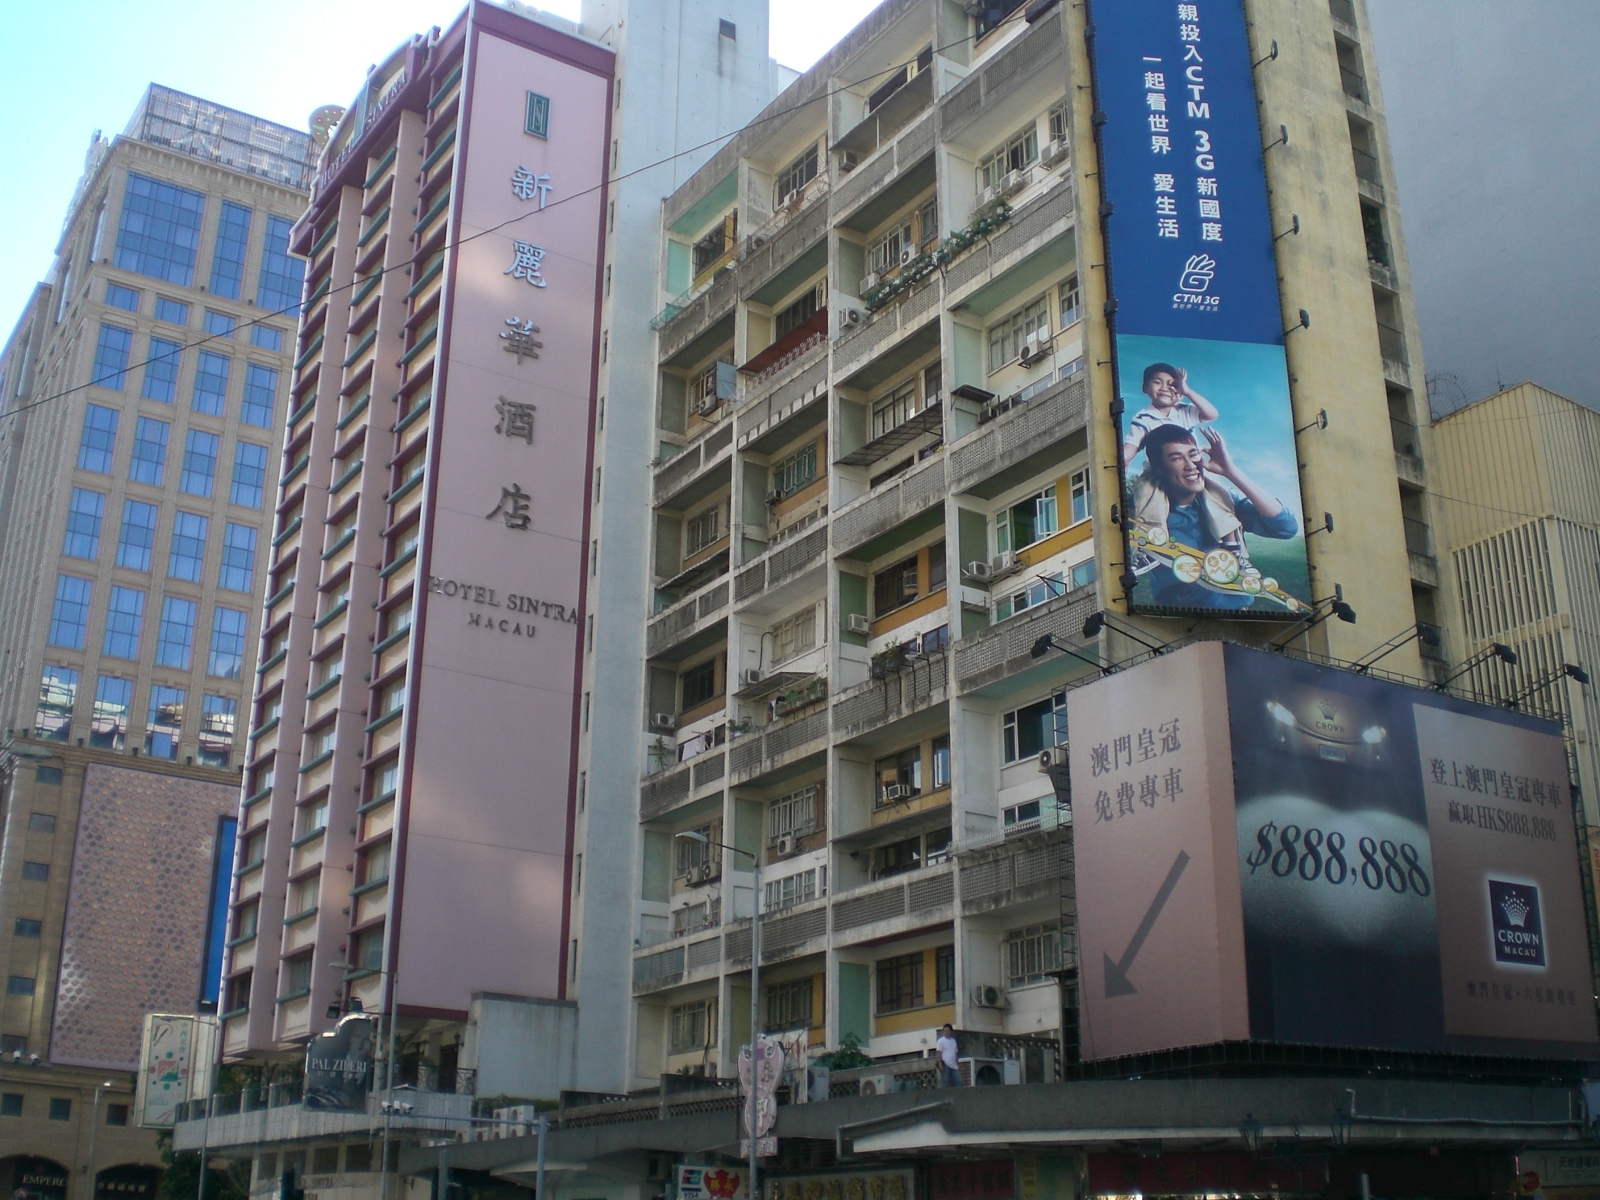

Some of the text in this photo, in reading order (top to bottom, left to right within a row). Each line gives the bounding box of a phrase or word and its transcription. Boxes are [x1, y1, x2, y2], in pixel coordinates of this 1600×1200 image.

[1142, 55, 1179, 238] 一起看世界 愛生活
[1172, 292, 1221, 305] CTM 3G
[486, 164, 553, 531] 新麗華酒店
[427, 575, 580, 625] HOTEL SINTRA
[468, 612, 537, 638] MACAU
[1090, 717, 1182, 778] 澳門皇冠
[1315, 721, 1346, 733] CROWN
[1093, 767, 1185, 825] 免費專車
[1429, 757, 1563, 810] 登上澳門皇冠專車
[1246, 820, 1435, 898] $888,888
[1498, 929, 1540, 946] CROWN
[1504, 945, 1537, 958] MACAU
[311, 1057, 331, 1071] PAL
